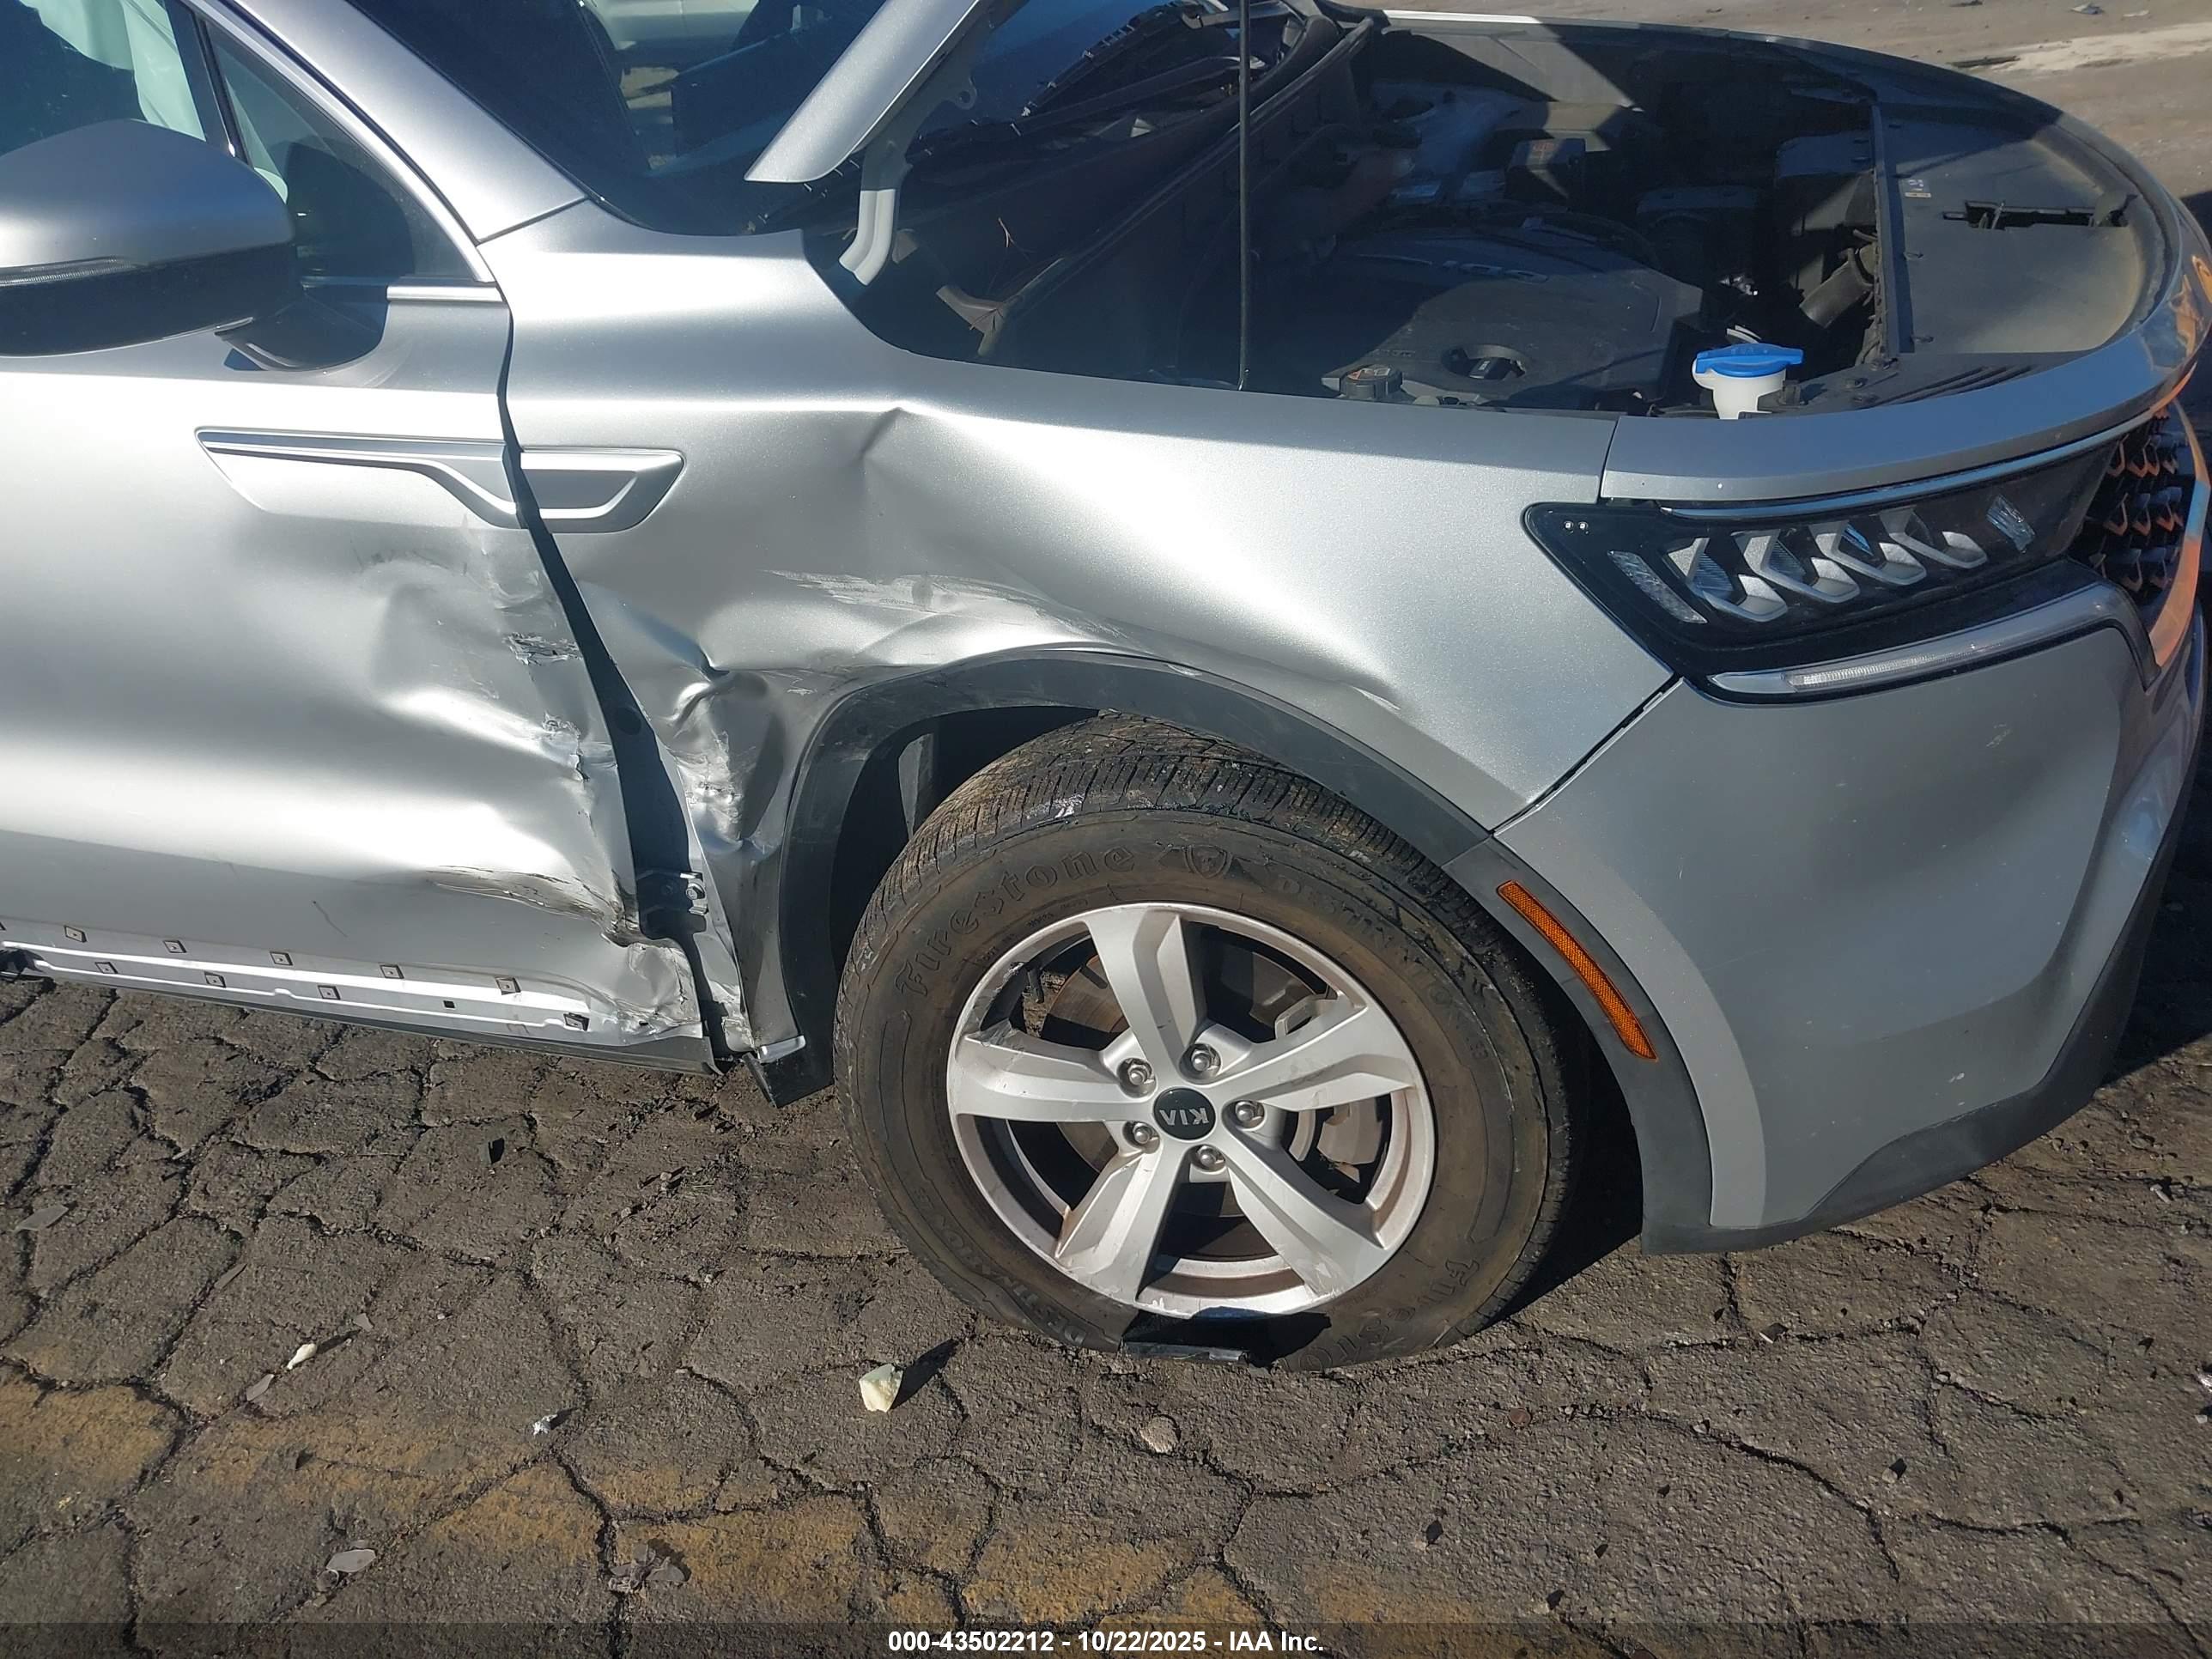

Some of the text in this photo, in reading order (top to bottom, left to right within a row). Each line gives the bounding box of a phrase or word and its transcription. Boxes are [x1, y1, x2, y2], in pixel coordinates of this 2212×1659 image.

[894, 845, 1136, 997] Firestone
[1159, 1108, 1209, 1126] KIA
[1285, 1256, 1480, 1372] Firesto
